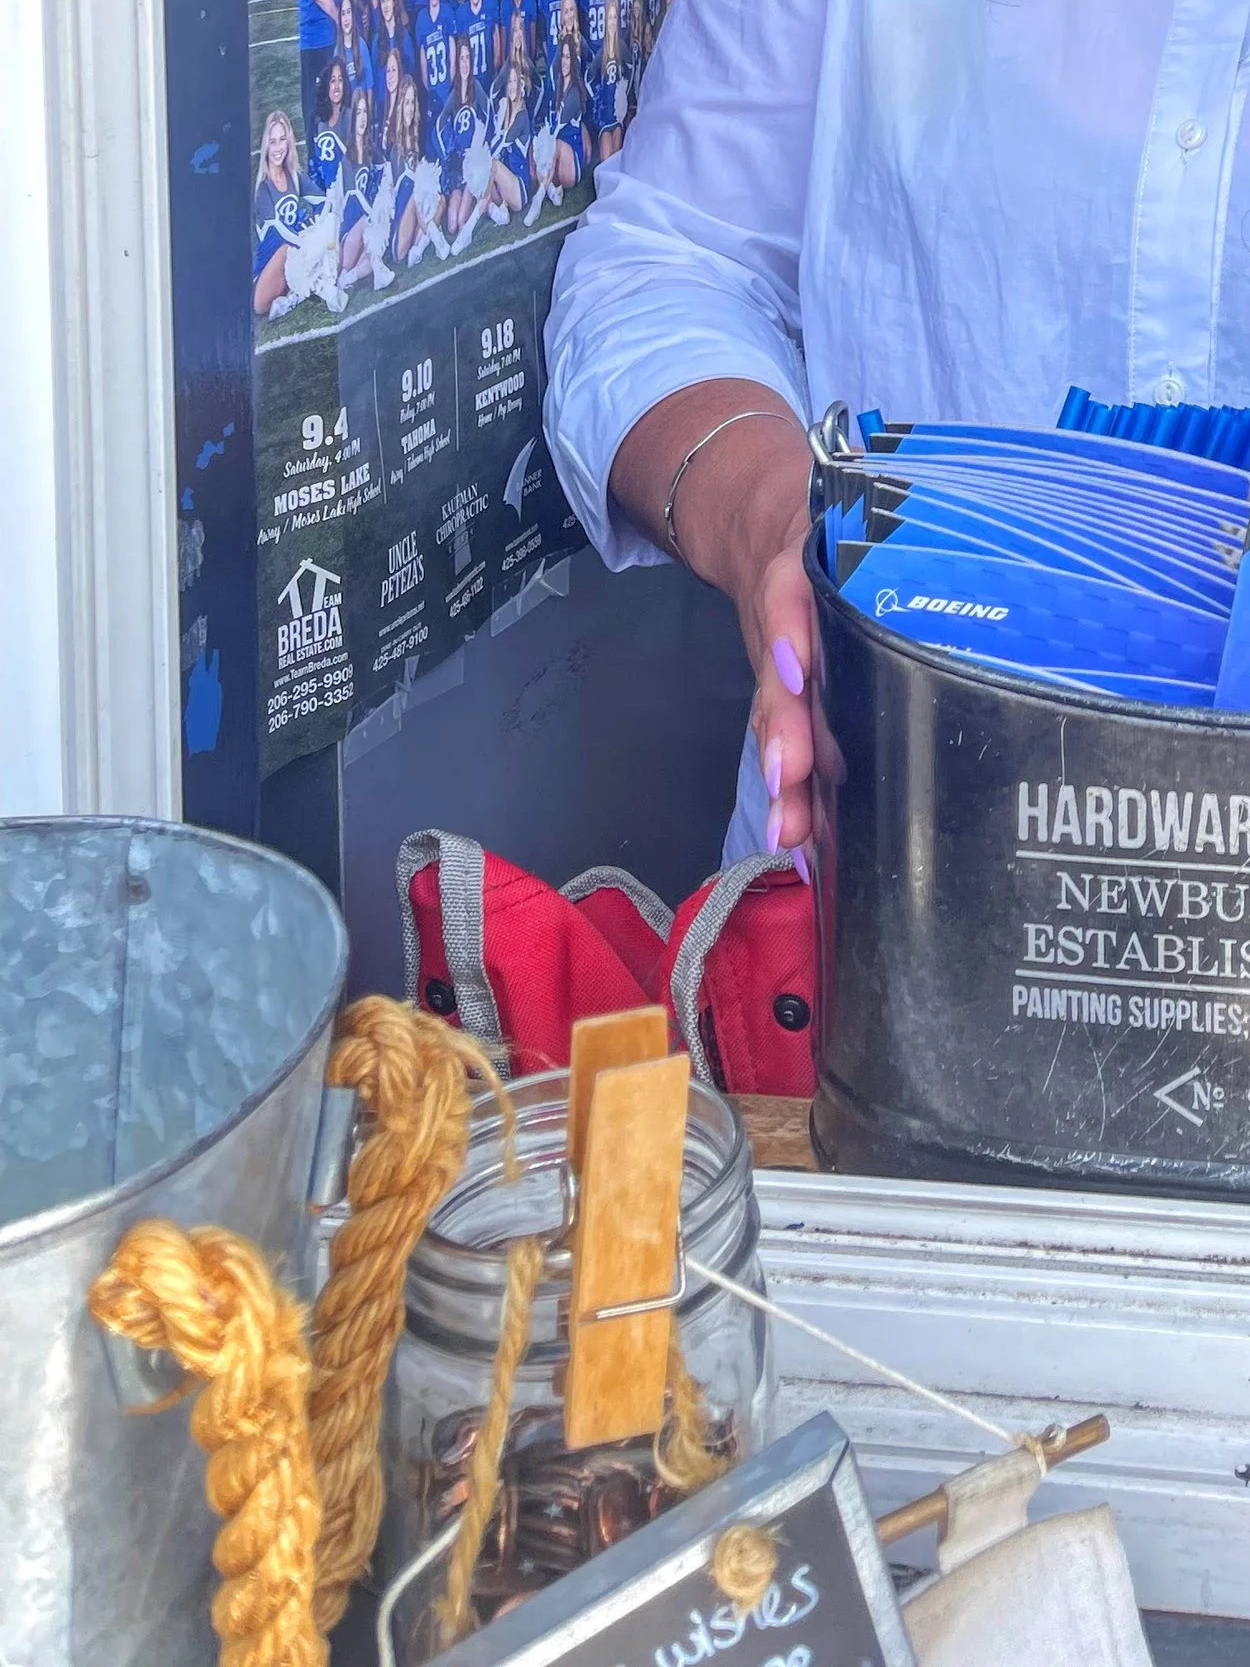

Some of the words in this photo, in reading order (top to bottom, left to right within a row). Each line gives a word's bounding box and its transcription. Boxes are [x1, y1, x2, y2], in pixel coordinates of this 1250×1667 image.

[426, 40, 447, 86] 33
[481, 317, 515, 359] 9.18
[401, 357, 433, 403] 9.10
[475, 371, 525, 412] KENTWOOD
[302, 405, 349, 451] 9.4
[400, 417, 437, 455] TAHOMA
[273, 479, 336, 517] MOSES
[340, 462, 371, 496] LAKE
[441, 482, 479, 521] KAUFMAN
[435, 493, 489, 545] CHIROPRACTIC
[388, 530, 418, 575] UNCLE
[380, 554, 426, 608] PETEZA'S
[277, 605, 343, 657] BREDA
[907, 594, 1009, 623] BOEING
[273, 652, 349, 689] www.TeamBreda.com
[278, 653, 296, 670] REAL
[296, 634, 344, 663] ESTATE.COM
[372, 625, 429, 673] 425-487-9100
[267, 663, 354, 715] 206-295-9909
[268, 681, 354, 734] 206-790-3352
[1012, 983, 1123, 1028] PAINTING
[1128, 997, 1249, 1042] SUPPLIES,
